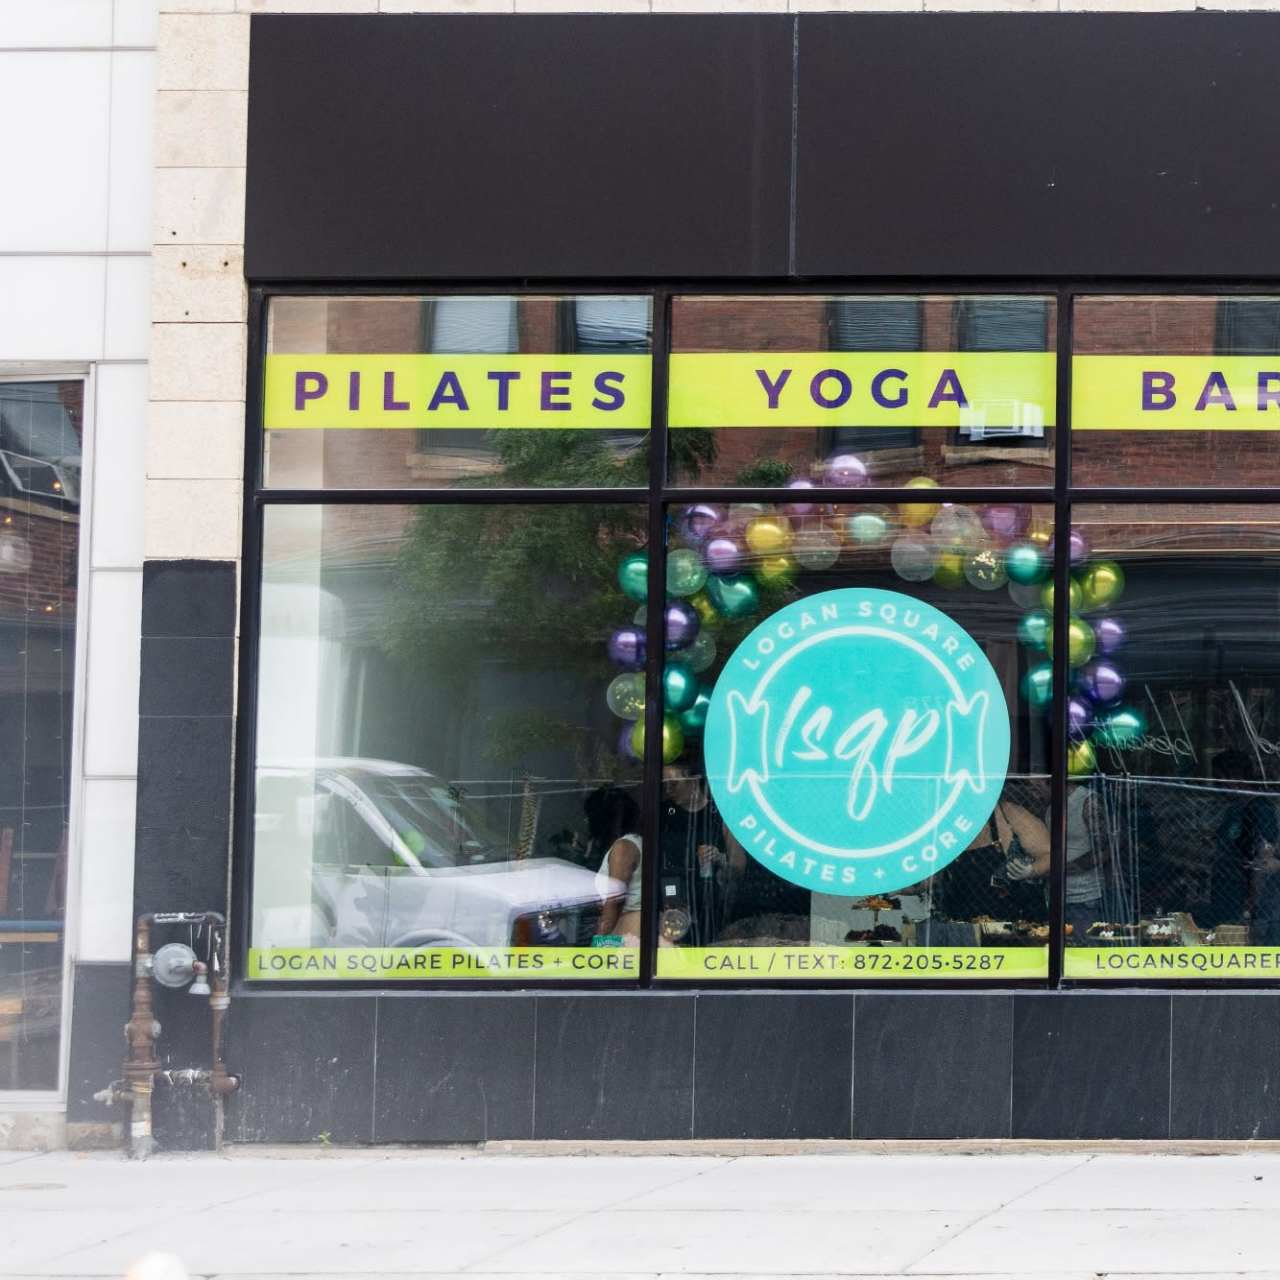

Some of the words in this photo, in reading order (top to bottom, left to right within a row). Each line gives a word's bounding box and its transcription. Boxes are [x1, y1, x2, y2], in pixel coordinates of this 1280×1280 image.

[293, 370, 627, 412] PILATES
[755, 368, 969, 410] YOGA
[743, 603, 838, 670] LOGAN
[858, 600, 975, 671] SQUARE
[739, 813, 856, 883] PILATES
[901, 815, 973, 873] CORE
[258, 954, 337, 970] LOGAN
[346, 953, 442, 972] SQUARE
[452, 953, 544, 969] PILATES
[553, 957, 562, 968] +
[572, 953, 635, 970] CORE
[703, 954, 759, 970] CALL
[767, 952, 776, 972] /
[784, 954, 846, 970] TEXT:
